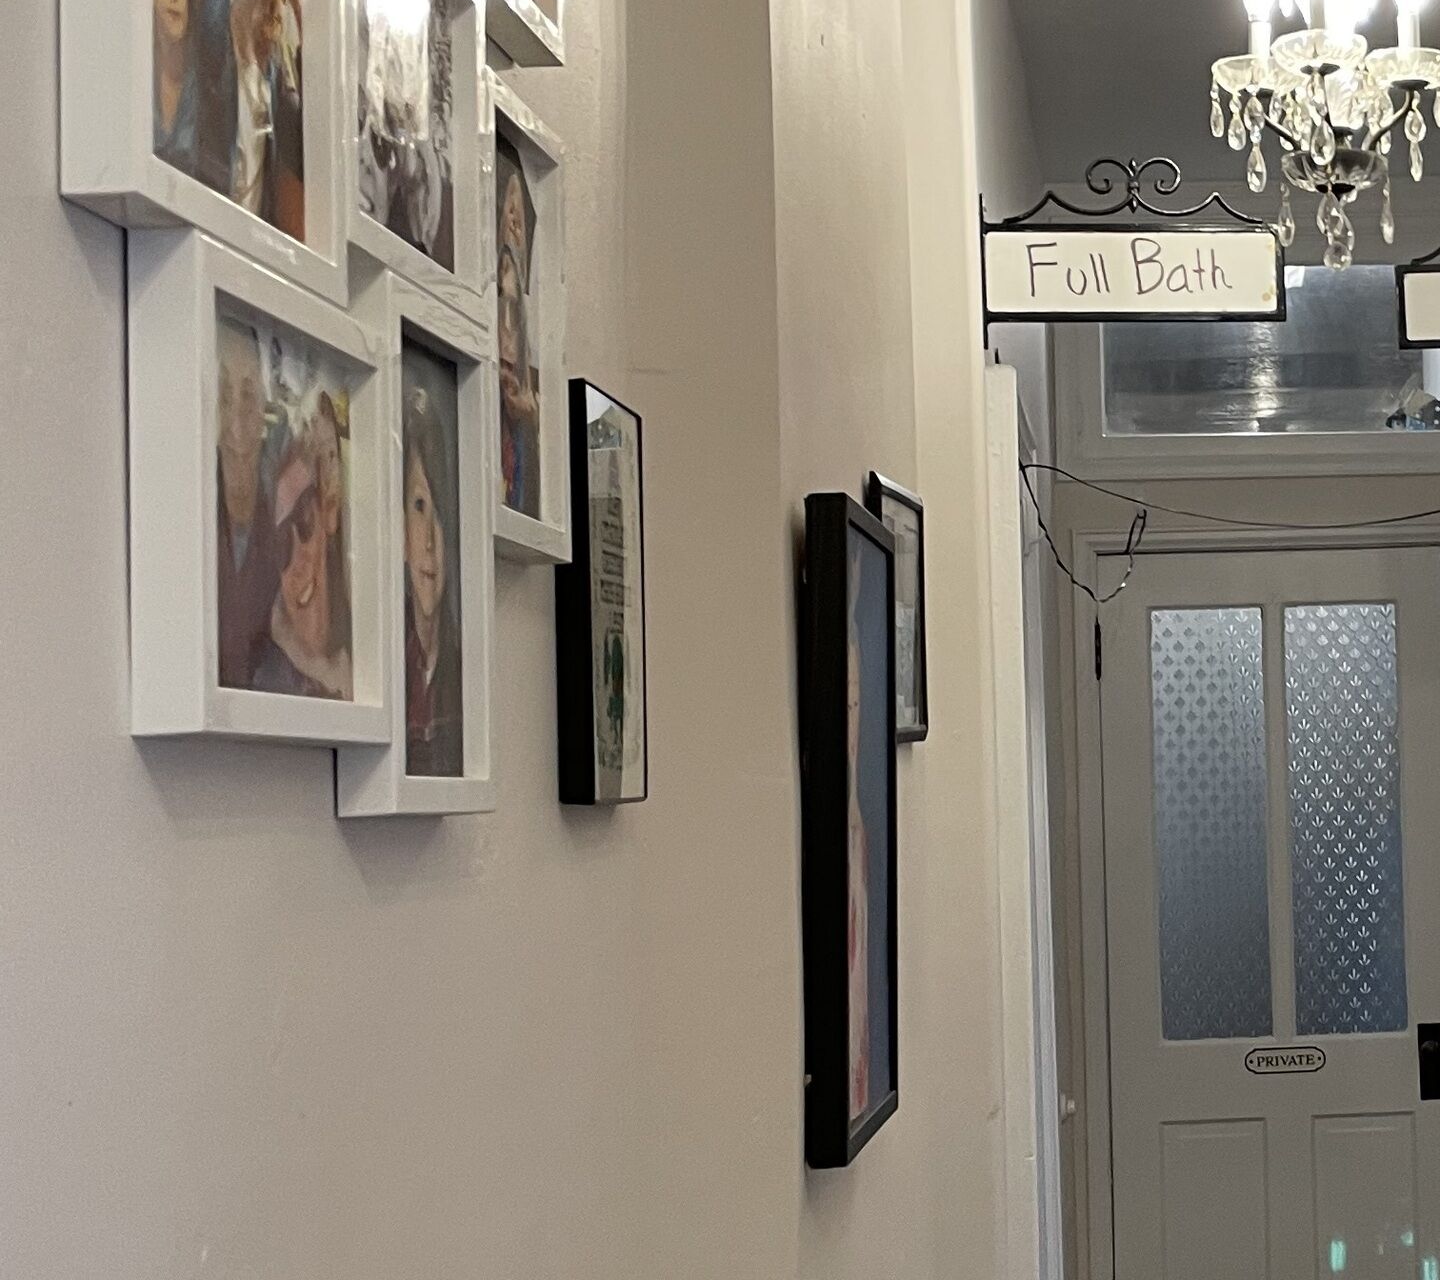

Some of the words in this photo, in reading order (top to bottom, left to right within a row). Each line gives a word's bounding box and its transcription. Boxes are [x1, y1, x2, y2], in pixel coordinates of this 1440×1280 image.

[1026, 241, 1110, 298] Full
[1132, 237, 1233, 296] Bath
[1257, 1054, 1315, 1067] PRIVATE
